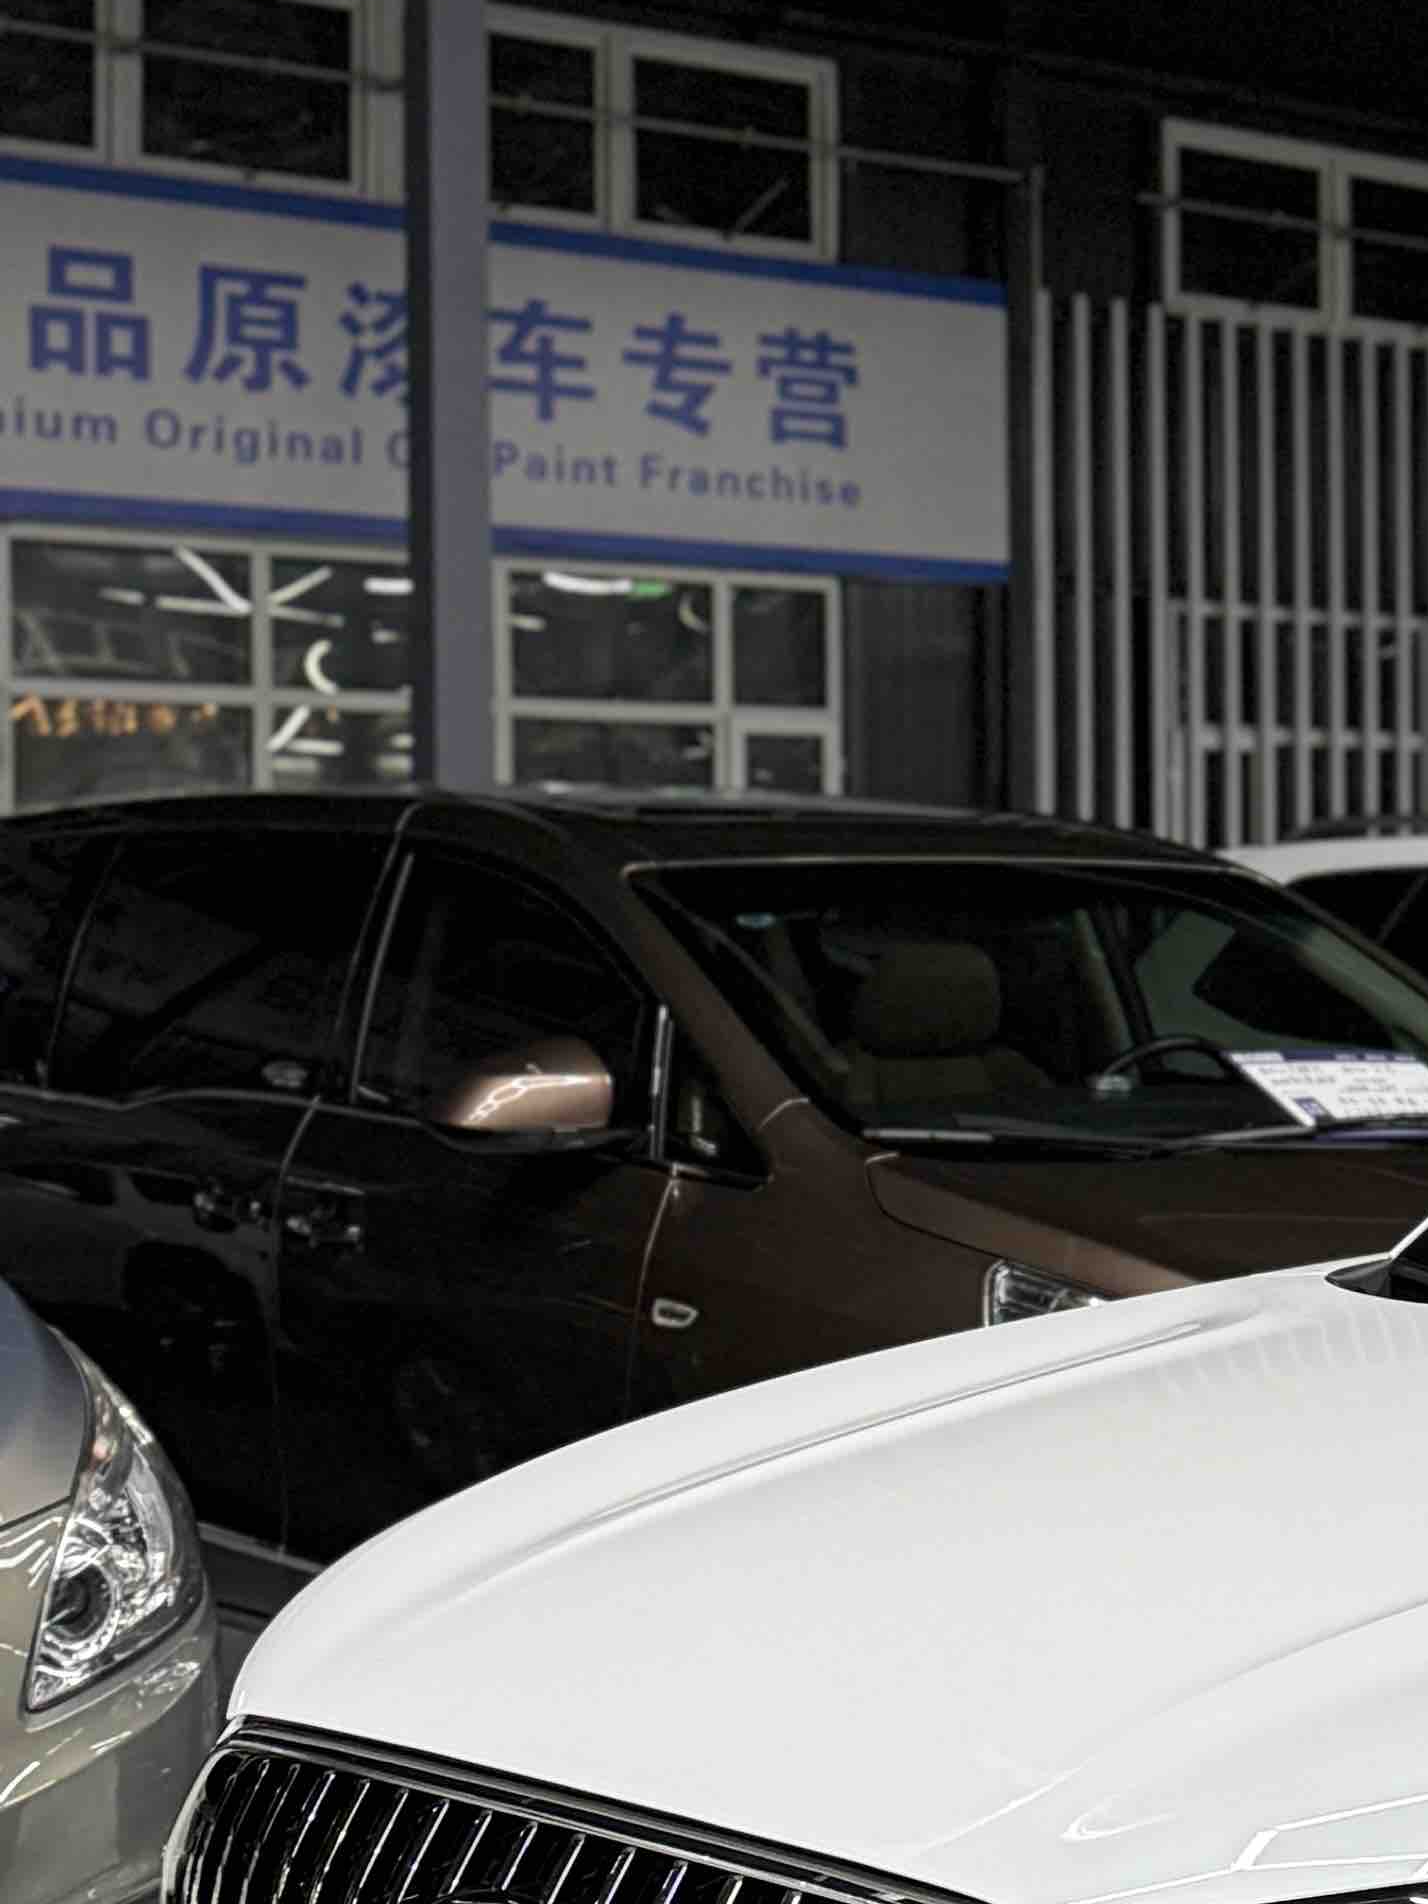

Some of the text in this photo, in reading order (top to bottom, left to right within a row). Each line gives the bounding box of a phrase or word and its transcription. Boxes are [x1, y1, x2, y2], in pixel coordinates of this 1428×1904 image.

[144, 408, 362, 464] Original
[492, 442, 616, 487] Paint
[639, 455, 863, 508] Franchise
